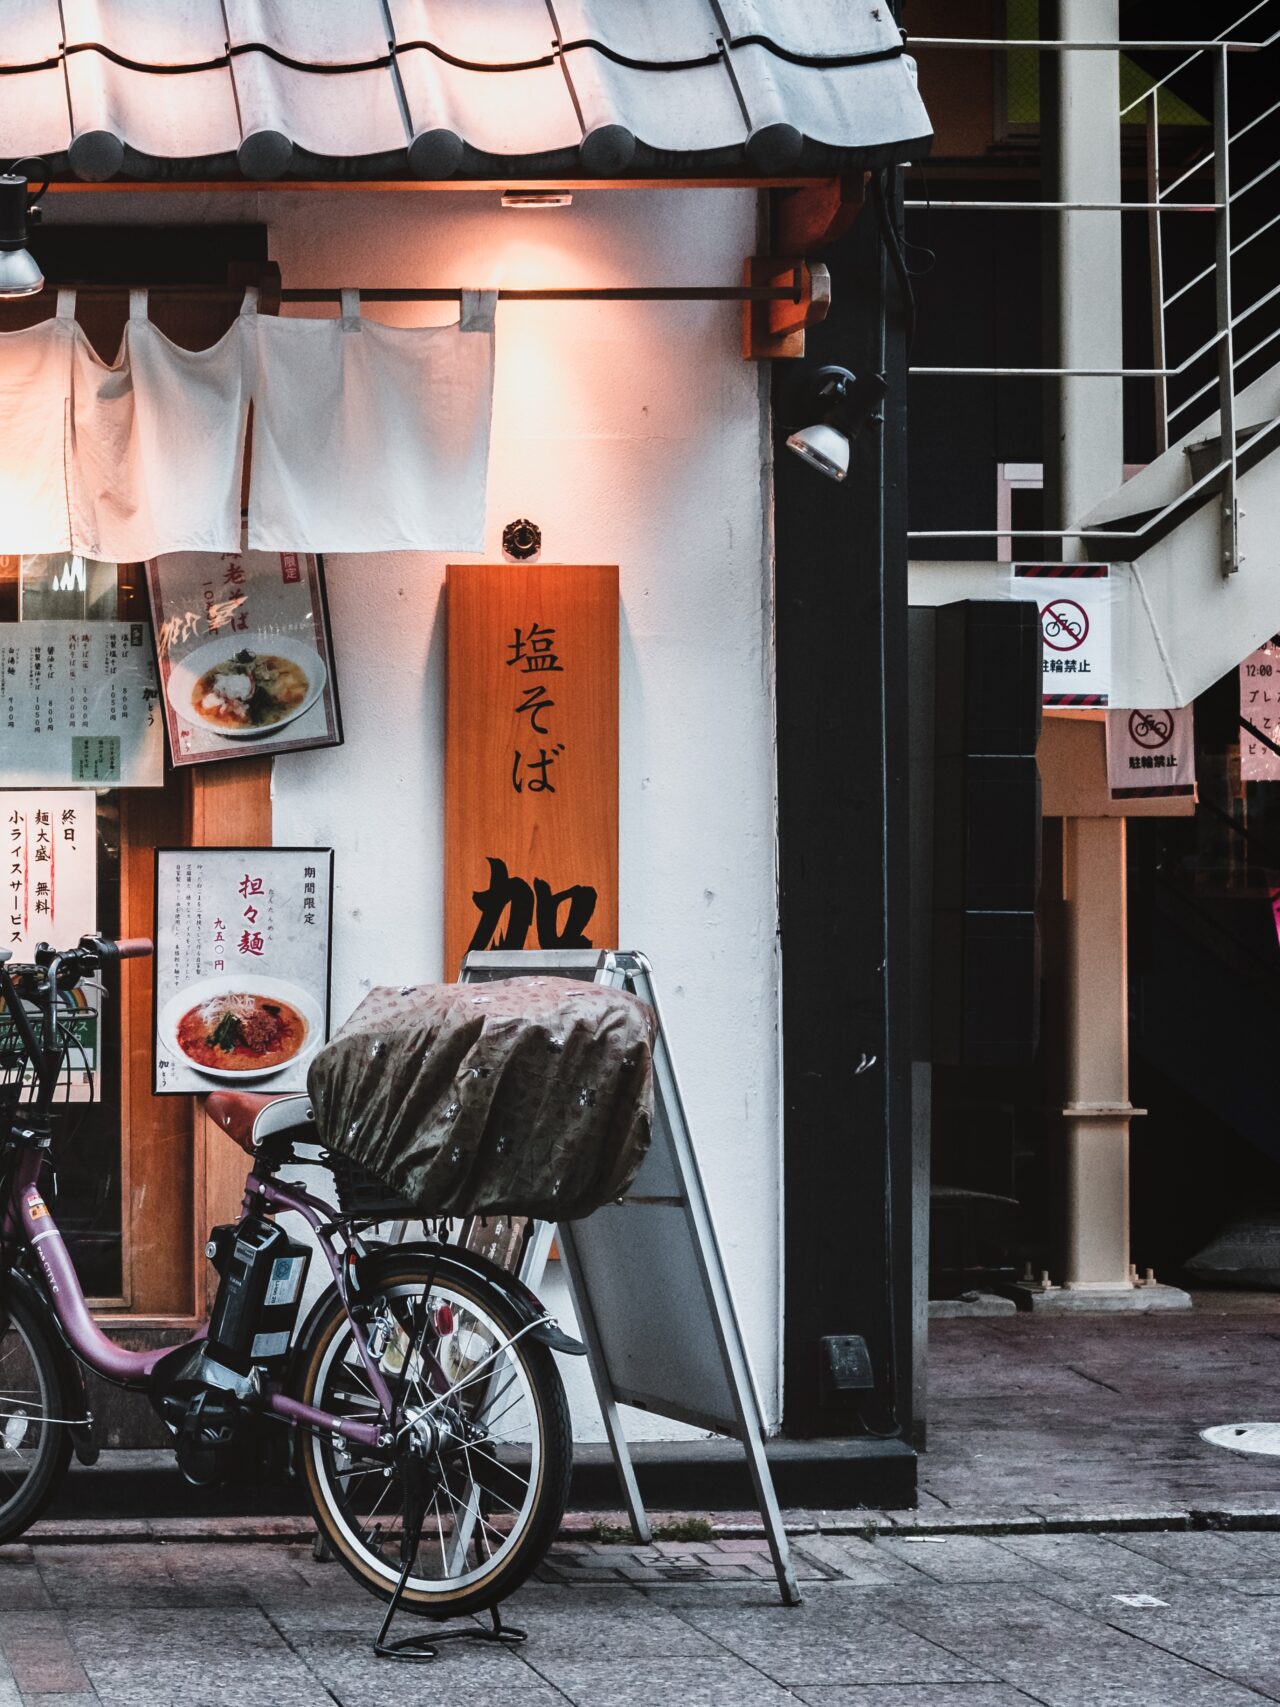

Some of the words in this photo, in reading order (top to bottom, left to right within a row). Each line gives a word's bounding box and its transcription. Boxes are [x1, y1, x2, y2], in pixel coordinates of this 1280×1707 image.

[282, 553, 298, 580] 限定
[1246, 664, 1273, 677] 12:00
[506, 623, 565, 793] 塩そば
[1129, 755, 1178, 769] 駐輪禁止
[61, 809, 77, 851] 終日、
[8, 810, 24, 943] 小ライスサービス
[303, 866, 316, 925] 期間限定
[237, 874, 265, 956] 担々麺
[214, 918, 226, 971] 九五〇円
